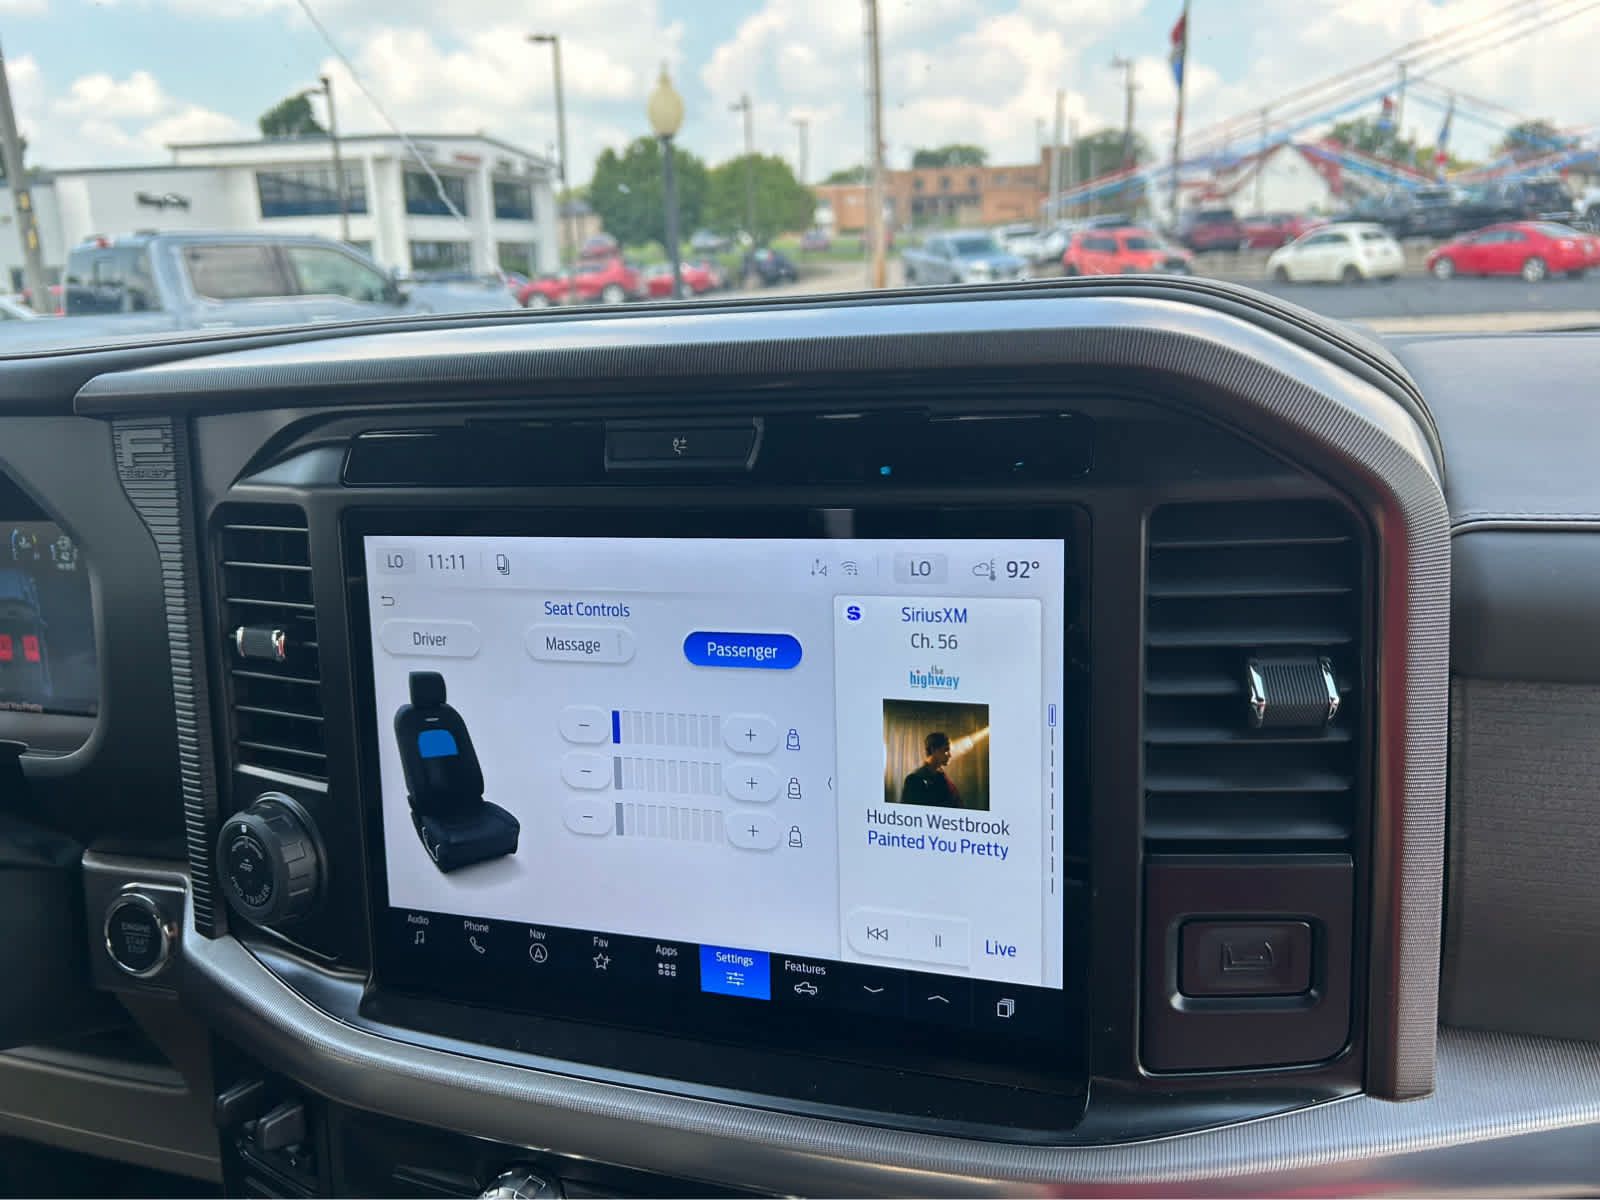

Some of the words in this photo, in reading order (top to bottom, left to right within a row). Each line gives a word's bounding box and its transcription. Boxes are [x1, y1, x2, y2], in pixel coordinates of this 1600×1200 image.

[387, 554, 404, 569] LO
[428, 554, 466, 570] 11:11
[910, 561, 931, 577] LO
[544, 601, 573, 617] Seat
[576, 602, 630, 618] Controls
[901, 607, 968, 624] SiriusXM
[413, 632, 447, 647] Driver
[545, 636, 601, 654] Massage
[910, 633, 934, 650] Ch.
[938, 634, 958, 650] 56
[707, 642, 778, 661] Passenger
[909, 670, 960, 690] highway
[866, 808, 923, 828] Hudson
[926, 814, 1010, 836] Westbrook
[868, 830, 926, 850] Painted
[927, 836, 957, 853] You
[960, 839, 1009, 861] Pretty
[407, 914, 429, 926] Audio
[463, 920, 489, 934] Phone
[529, 928, 546, 940] Nav
[593, 936, 609, 948] Fav
[655, 945, 678, 957] Apps
[985, 939, 1017, 957] Live
[715, 951, 754, 966] Settings
[784, 960, 826, 976] Features
